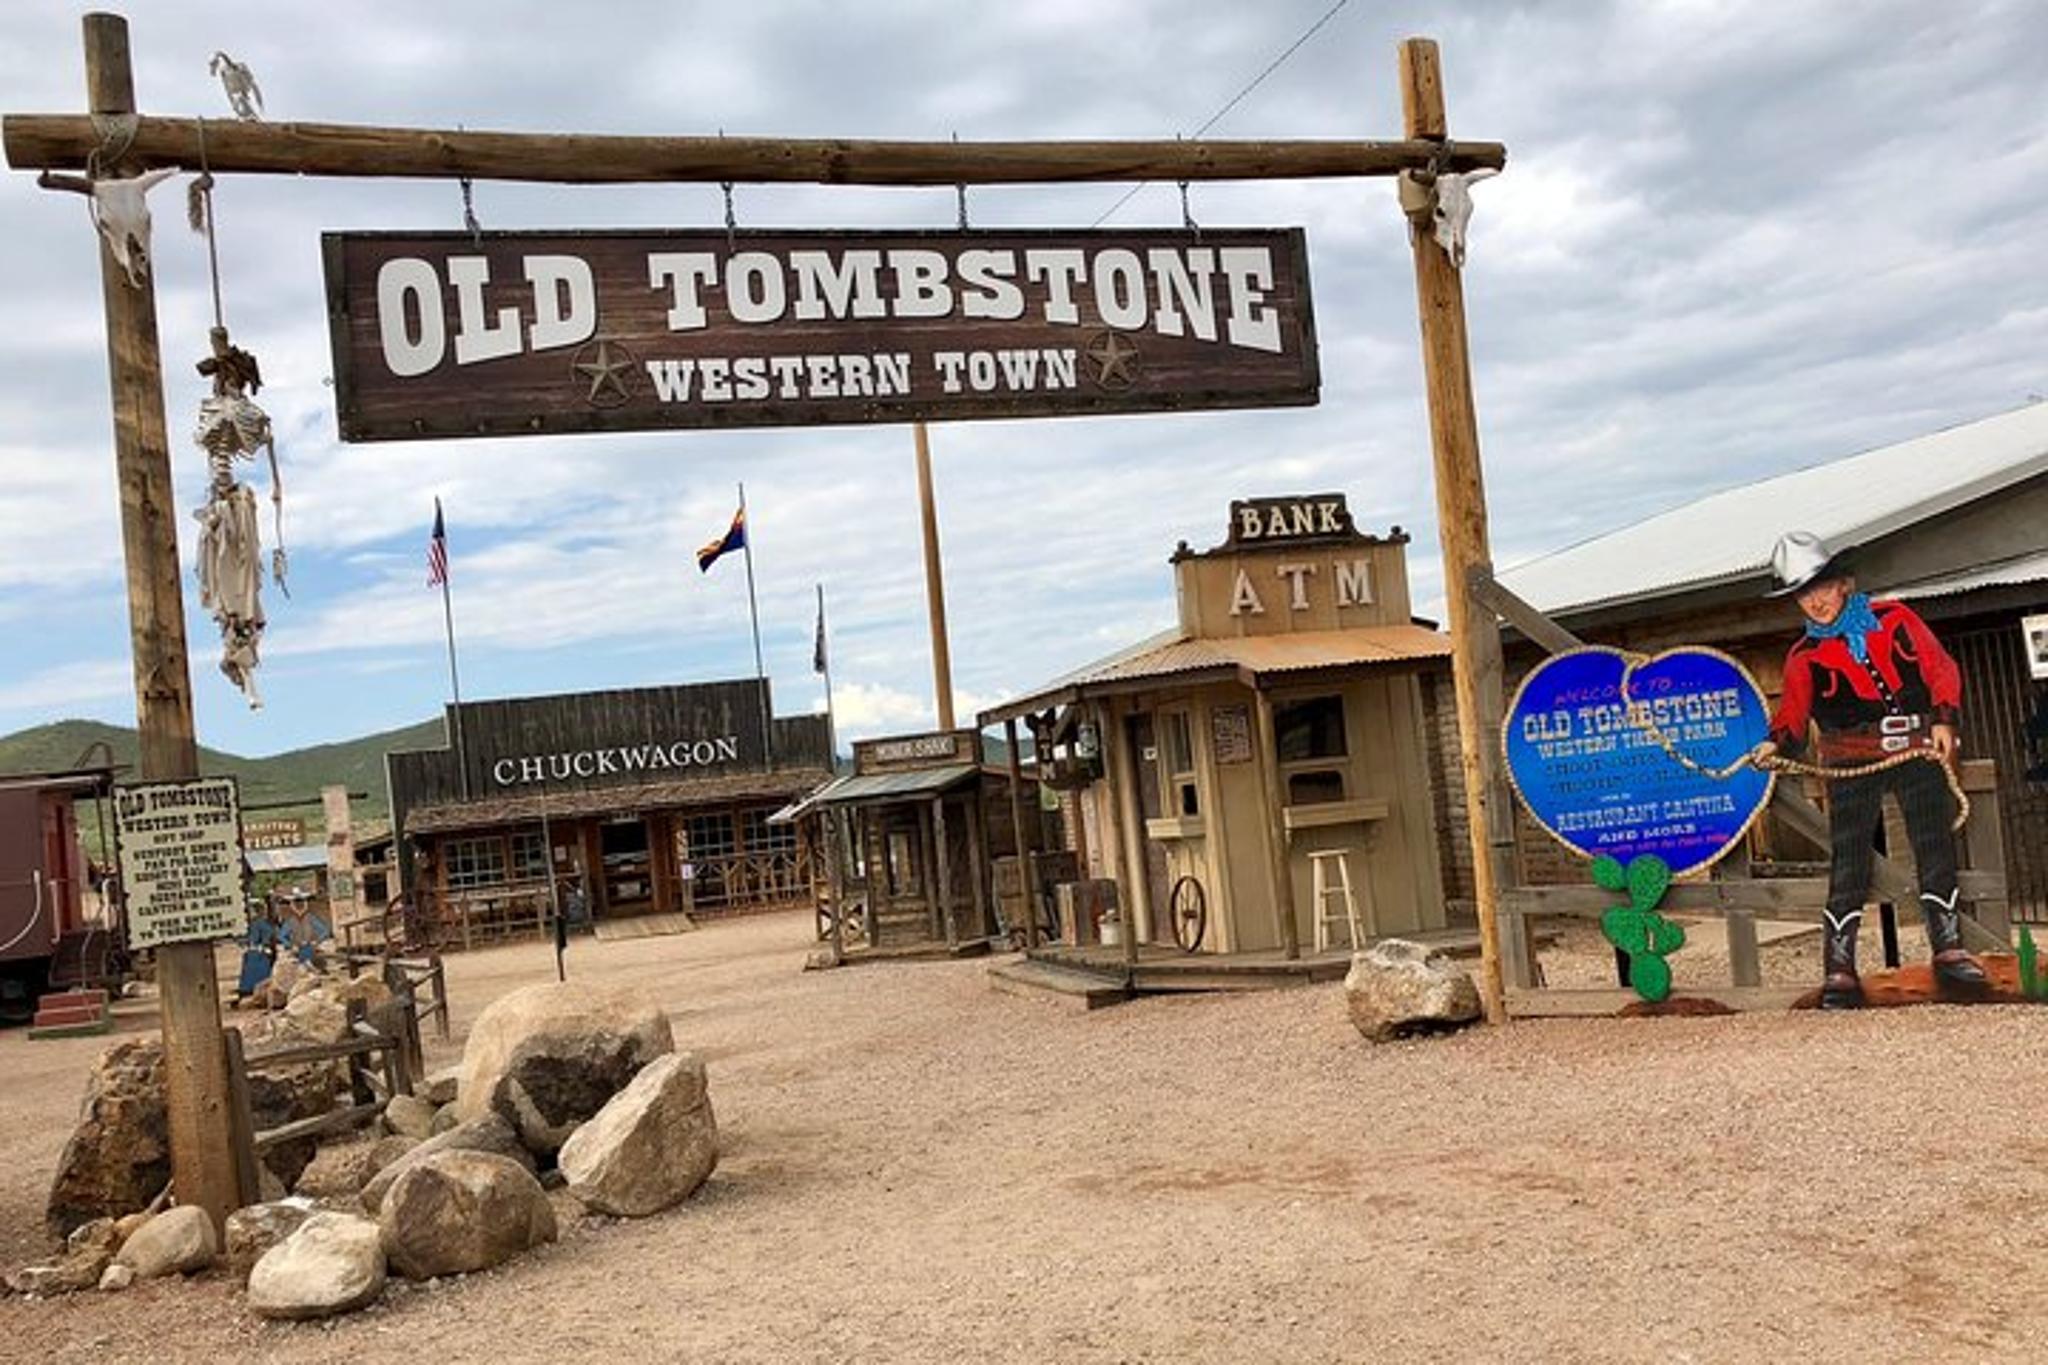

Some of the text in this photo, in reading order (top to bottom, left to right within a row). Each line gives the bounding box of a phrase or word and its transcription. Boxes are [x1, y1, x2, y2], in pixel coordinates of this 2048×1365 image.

[376, 245, 1282, 377] OLD TOMBSTONE
[645, 347, 1078, 403] WESTERN TOWN
[1239, 502, 1343, 539] BANK
[1228, 558, 1374, 616] ATM
[1523, 688, 1742, 743] OLD TOMBSTONE
[493, 736, 739, 785] CHUCKWAGON
[1537, 735, 1617, 760] WESTERN
[120, 784, 231, 820] OLD TOMBSTONE
[123, 814, 189, 833] WESTERN
[194, 810, 232, 826] TOWN
[1598, 830, 1639, 844] AND
[190, 841, 226, 854] SHOWS
[139, 930, 154, 940] TO
